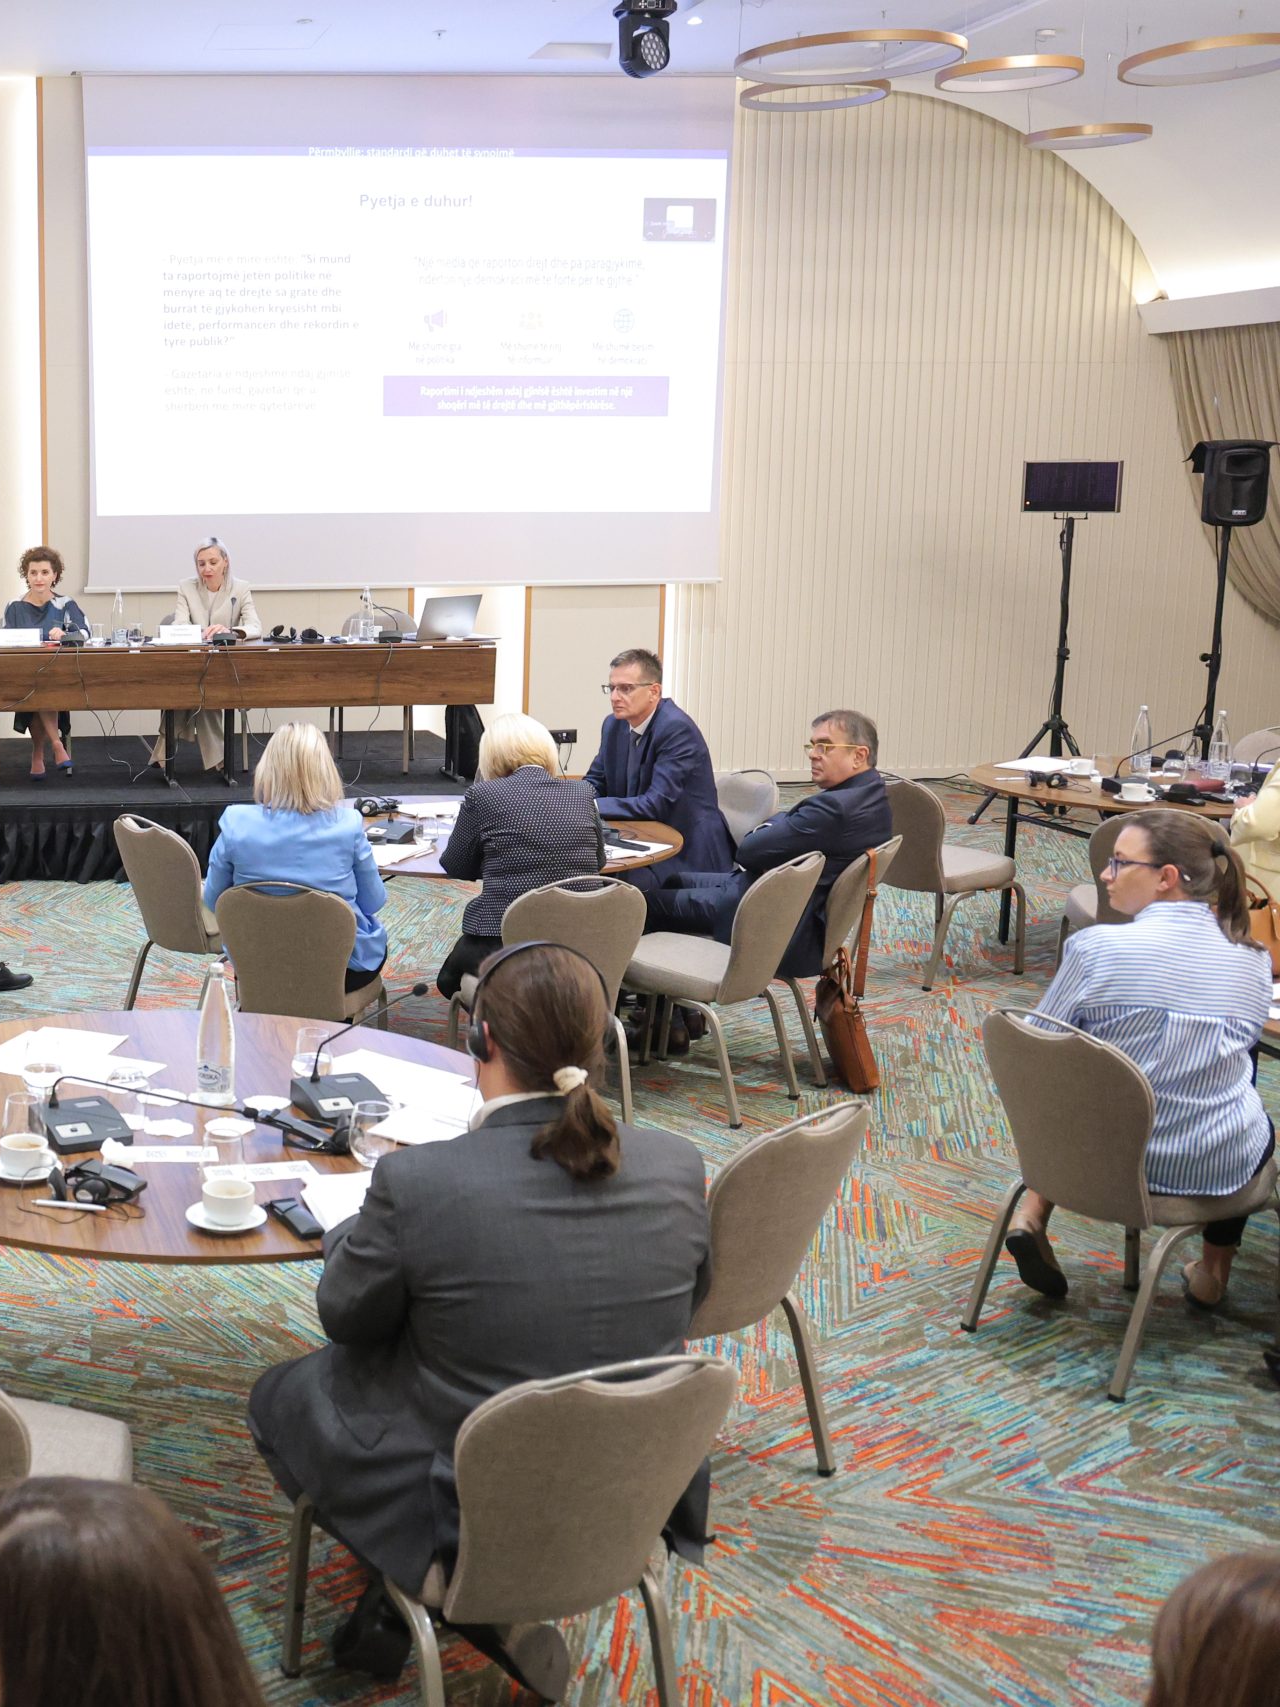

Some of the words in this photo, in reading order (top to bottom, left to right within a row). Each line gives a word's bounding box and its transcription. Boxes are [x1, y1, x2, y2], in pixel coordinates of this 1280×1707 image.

[359, 194, 406, 210] Pyetja
[411, 198, 419, 207] e
[424, 194, 473, 207] duhur!
[319, 253, 351, 264] mund
[163, 271, 174, 281] ta
[274, 269, 315, 282] politike
[275, 288, 287, 297] sa
[320, 286, 343, 297] dhe
[163, 303, 197, 314] burrat
[268, 302, 317, 316] kryesisht
[321, 302, 342, 313] mbi
[280, 319, 300, 330] dhe
[303, 319, 350, 331] rekordin
[163, 336, 186, 349] tyre
